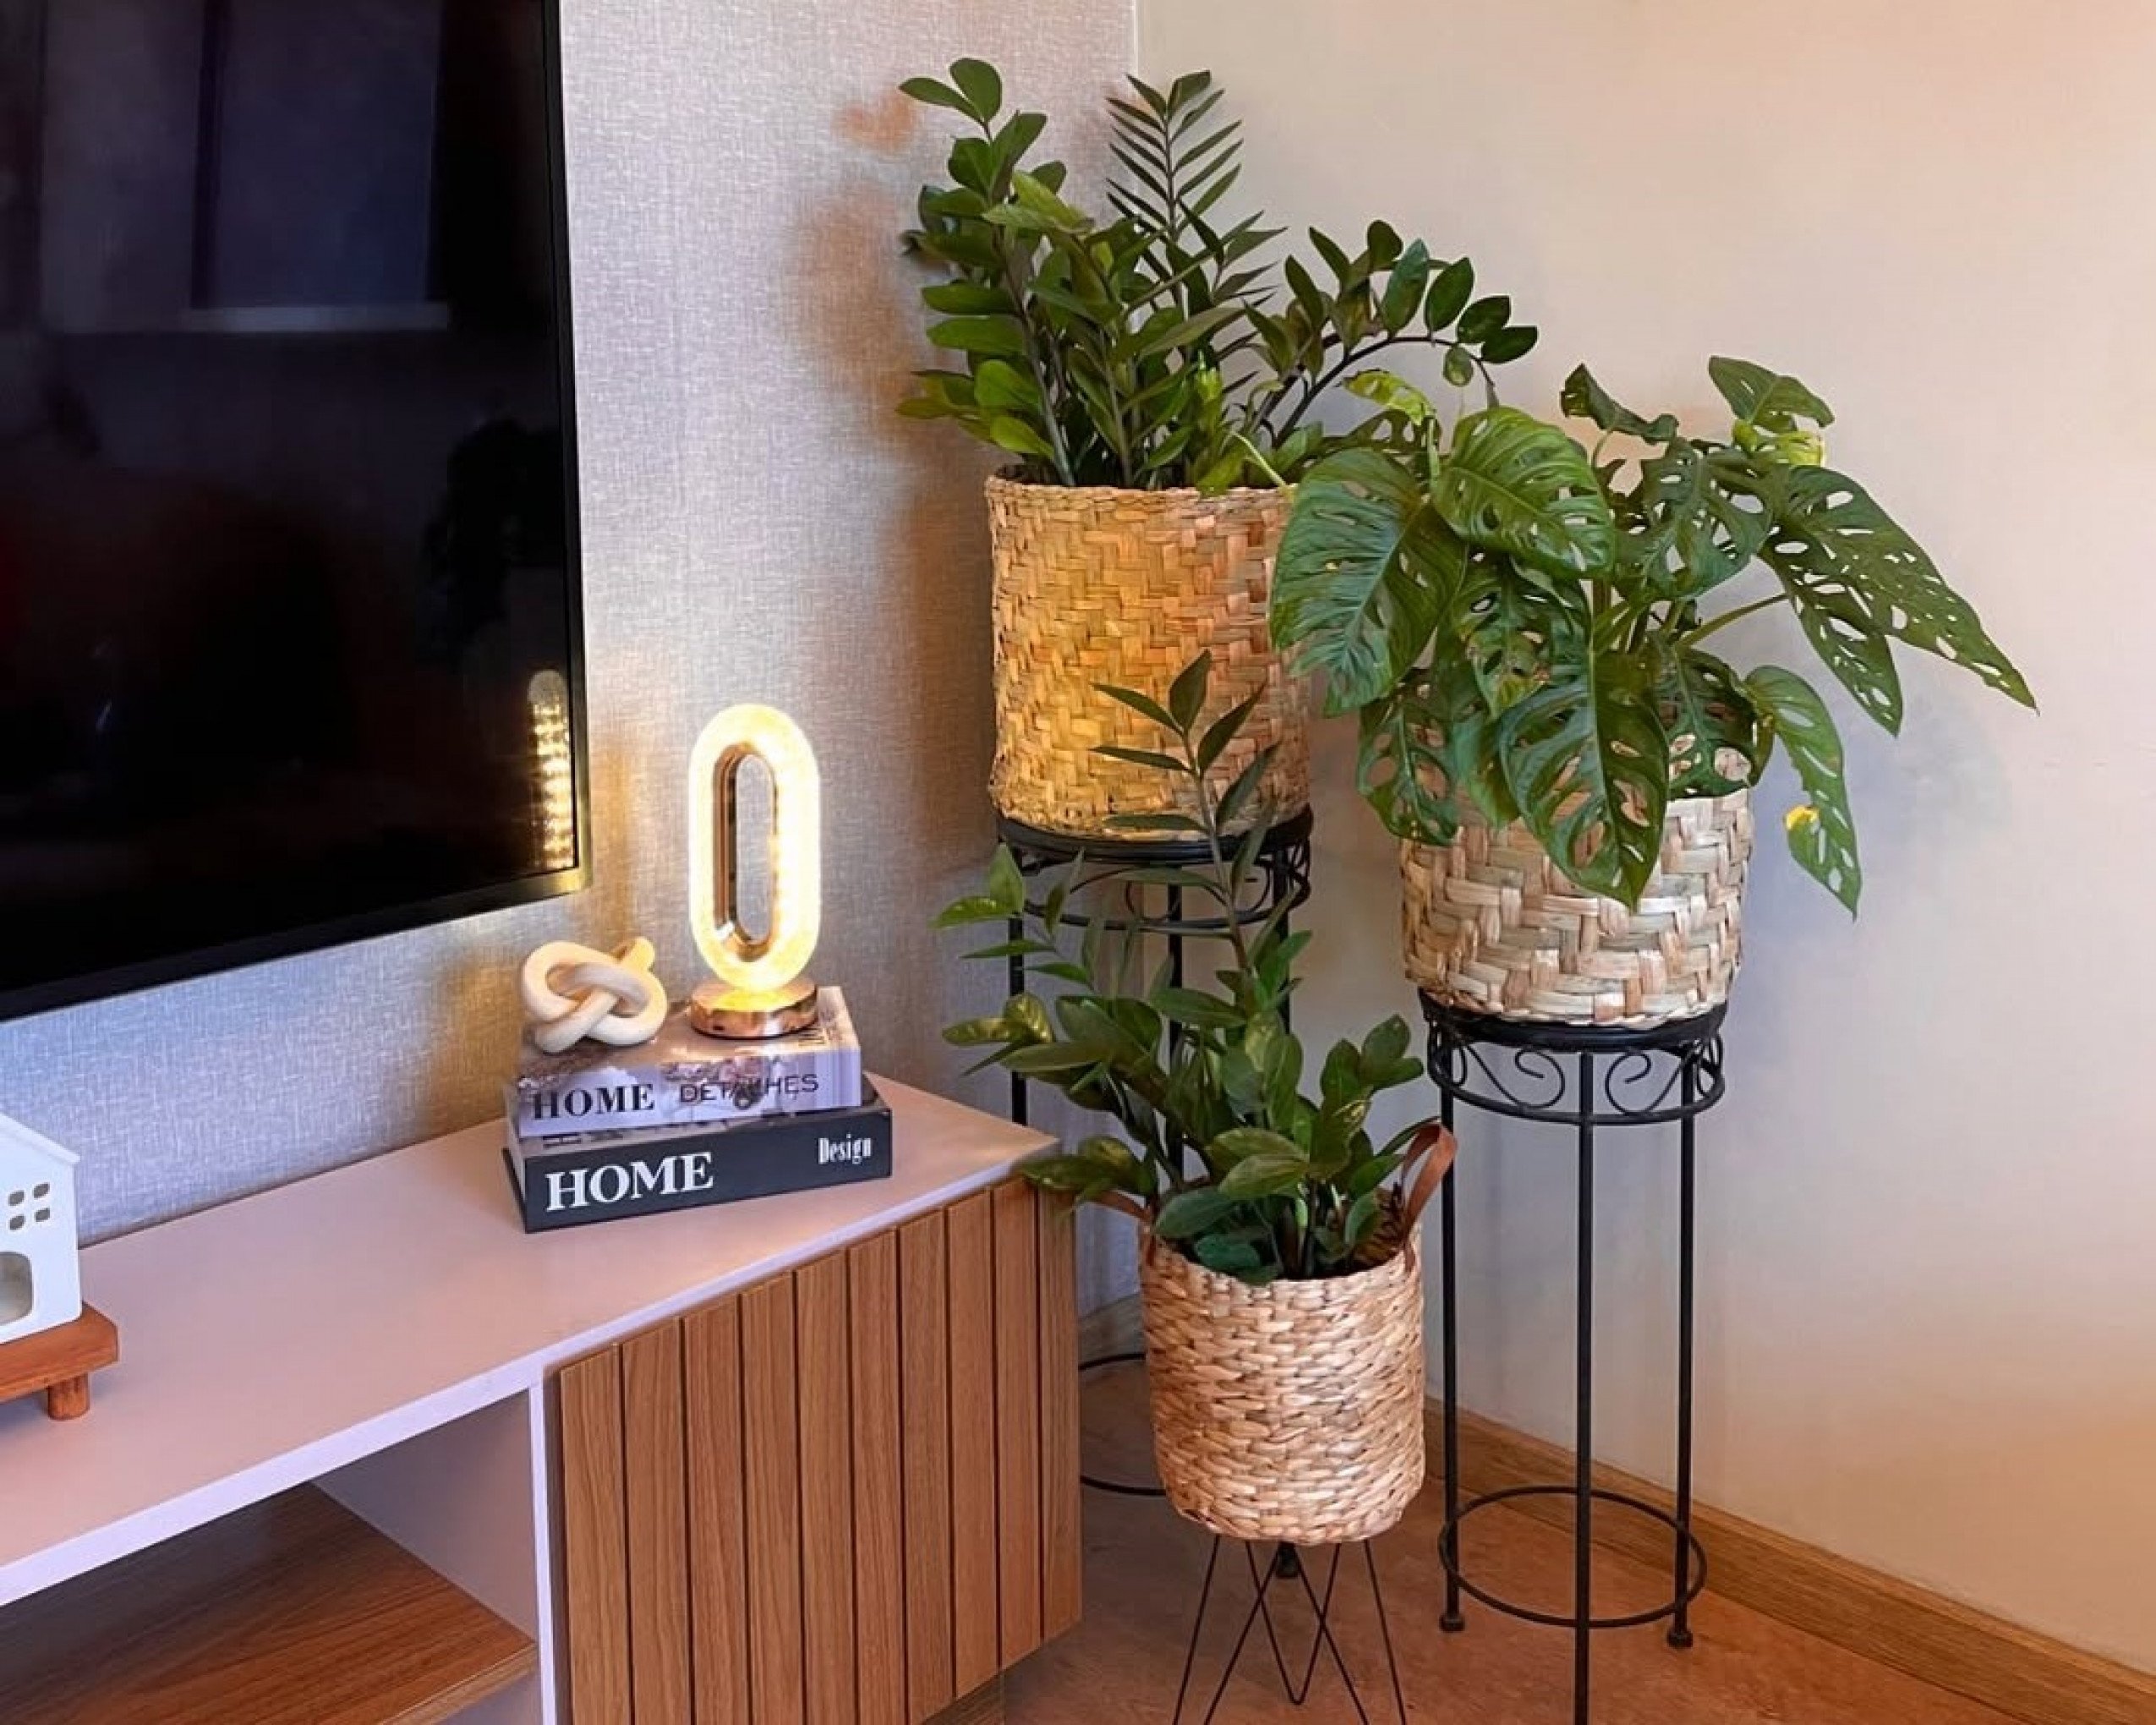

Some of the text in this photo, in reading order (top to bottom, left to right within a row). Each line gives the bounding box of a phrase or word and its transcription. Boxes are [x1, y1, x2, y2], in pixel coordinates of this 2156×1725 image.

[533, 1074, 819, 1120] HOME DETAHES
[546, 1134, 872, 1211] HOME Design
